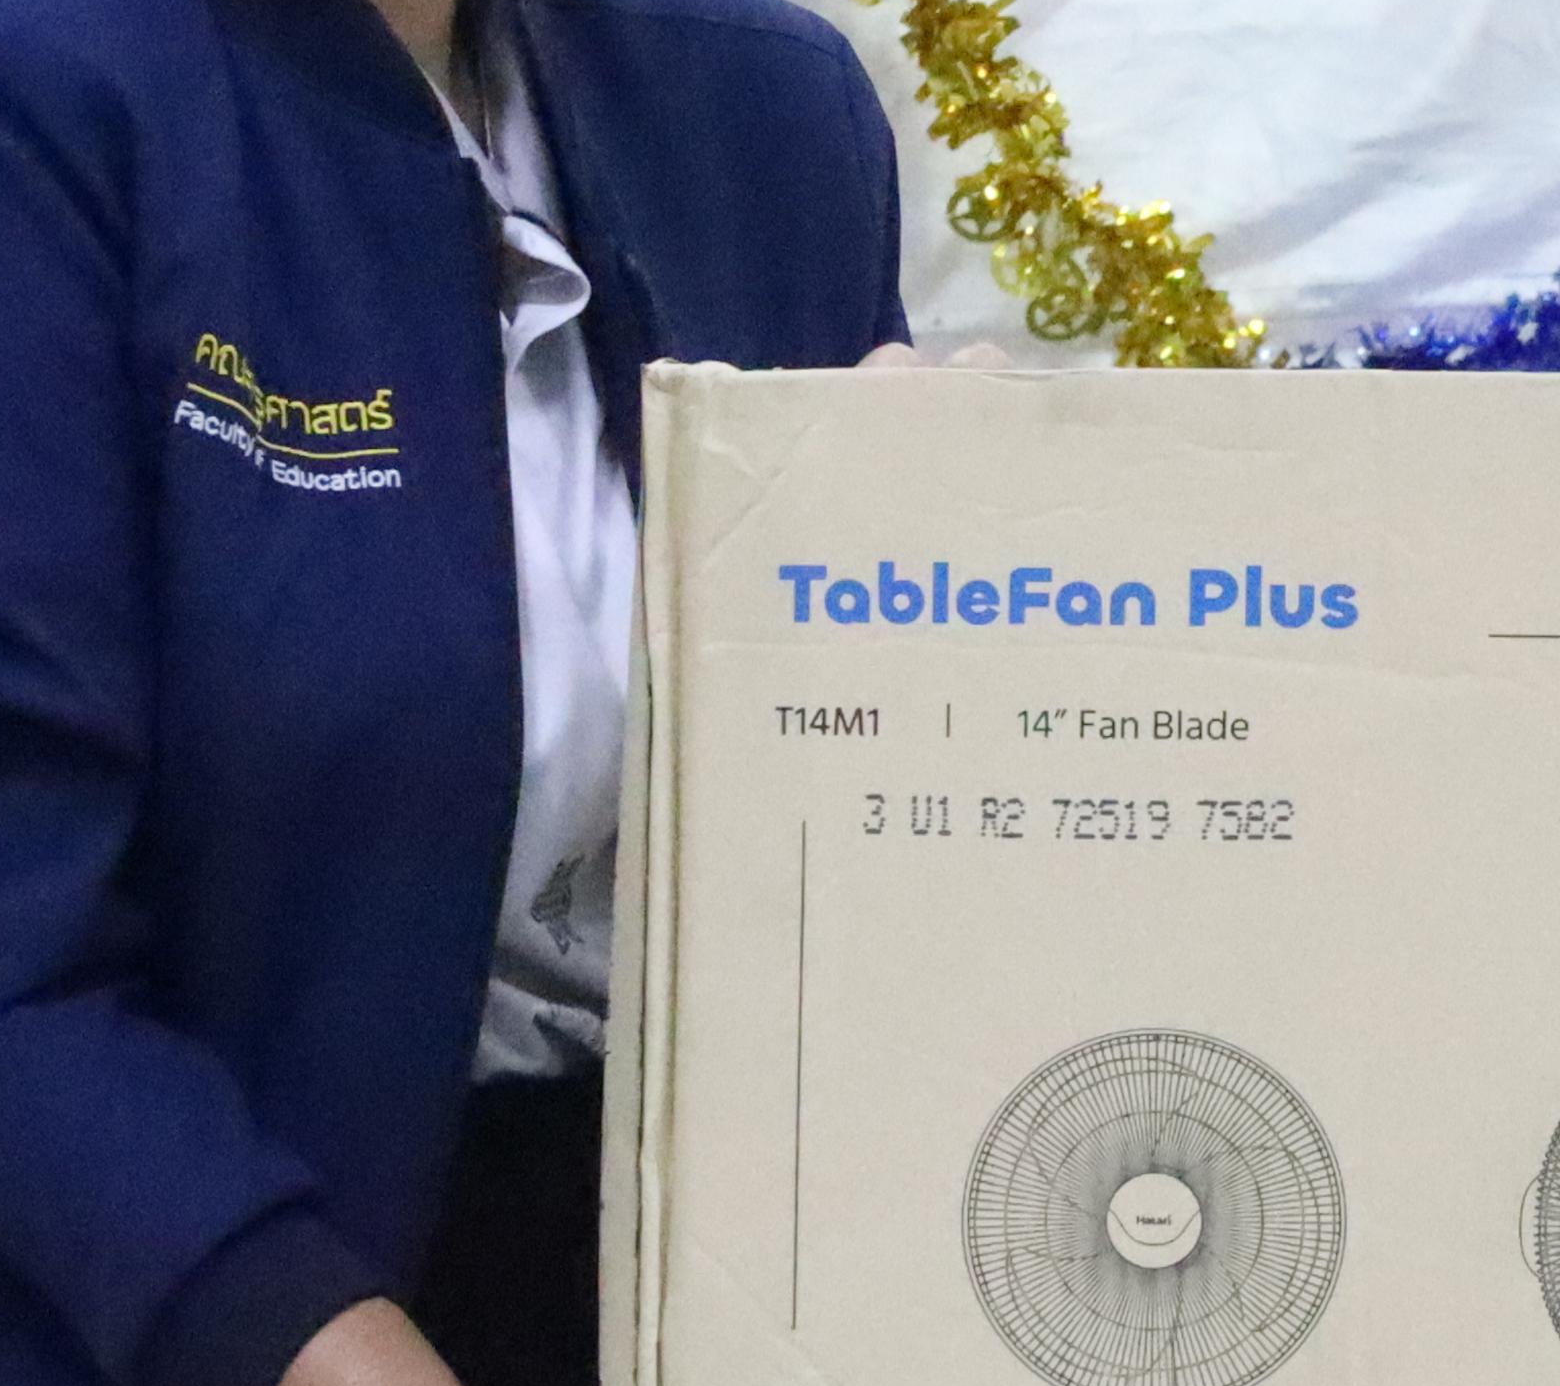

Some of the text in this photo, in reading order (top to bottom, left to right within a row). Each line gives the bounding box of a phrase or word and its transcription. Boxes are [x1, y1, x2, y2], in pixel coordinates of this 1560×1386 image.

[174, 399, 256, 456] Faculty
[271, 459, 403, 492] Education
[779, 561, 1359, 630] TableFan Plus
[776, 707, 880, 737] T14M1
[1079, 710, 1140, 741] Fan
[1154, 710, 1251, 742] Blade
[863, 794, 886, 836] 3
[1052, 799, 1171, 841] 72519
